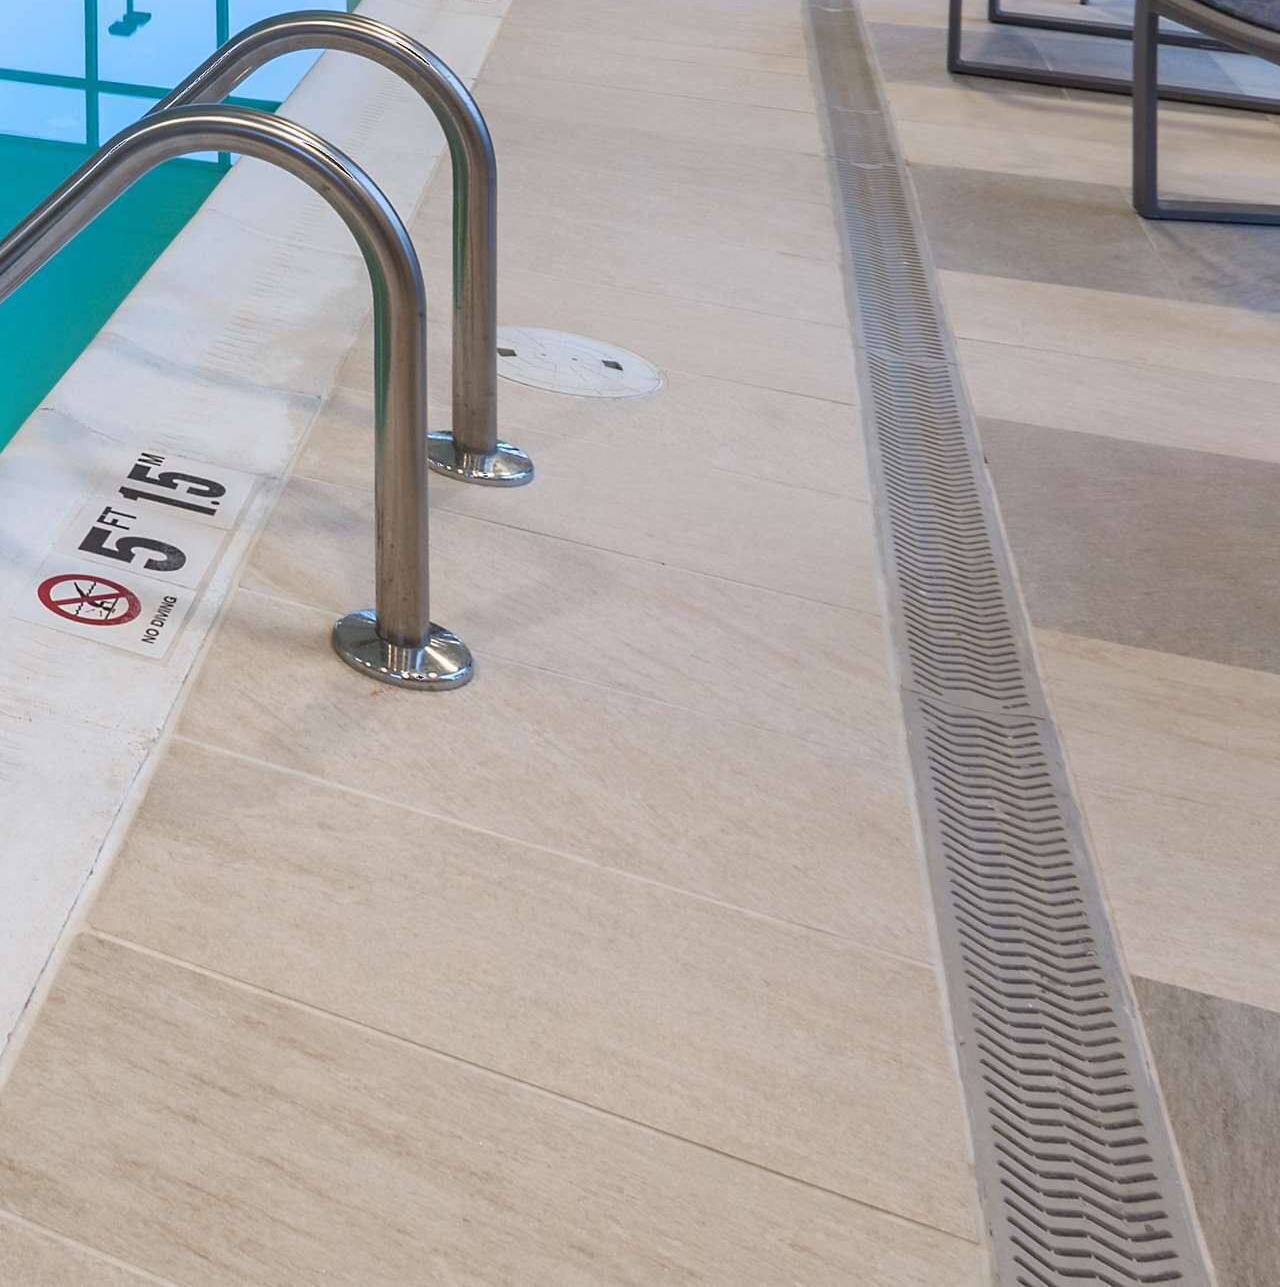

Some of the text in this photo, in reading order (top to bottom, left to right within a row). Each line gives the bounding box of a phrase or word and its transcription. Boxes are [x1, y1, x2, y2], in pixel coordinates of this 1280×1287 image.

[77, 452, 227, 572] 5 FT 1.5 M
[141, 594, 178, 645] NO DIVING
